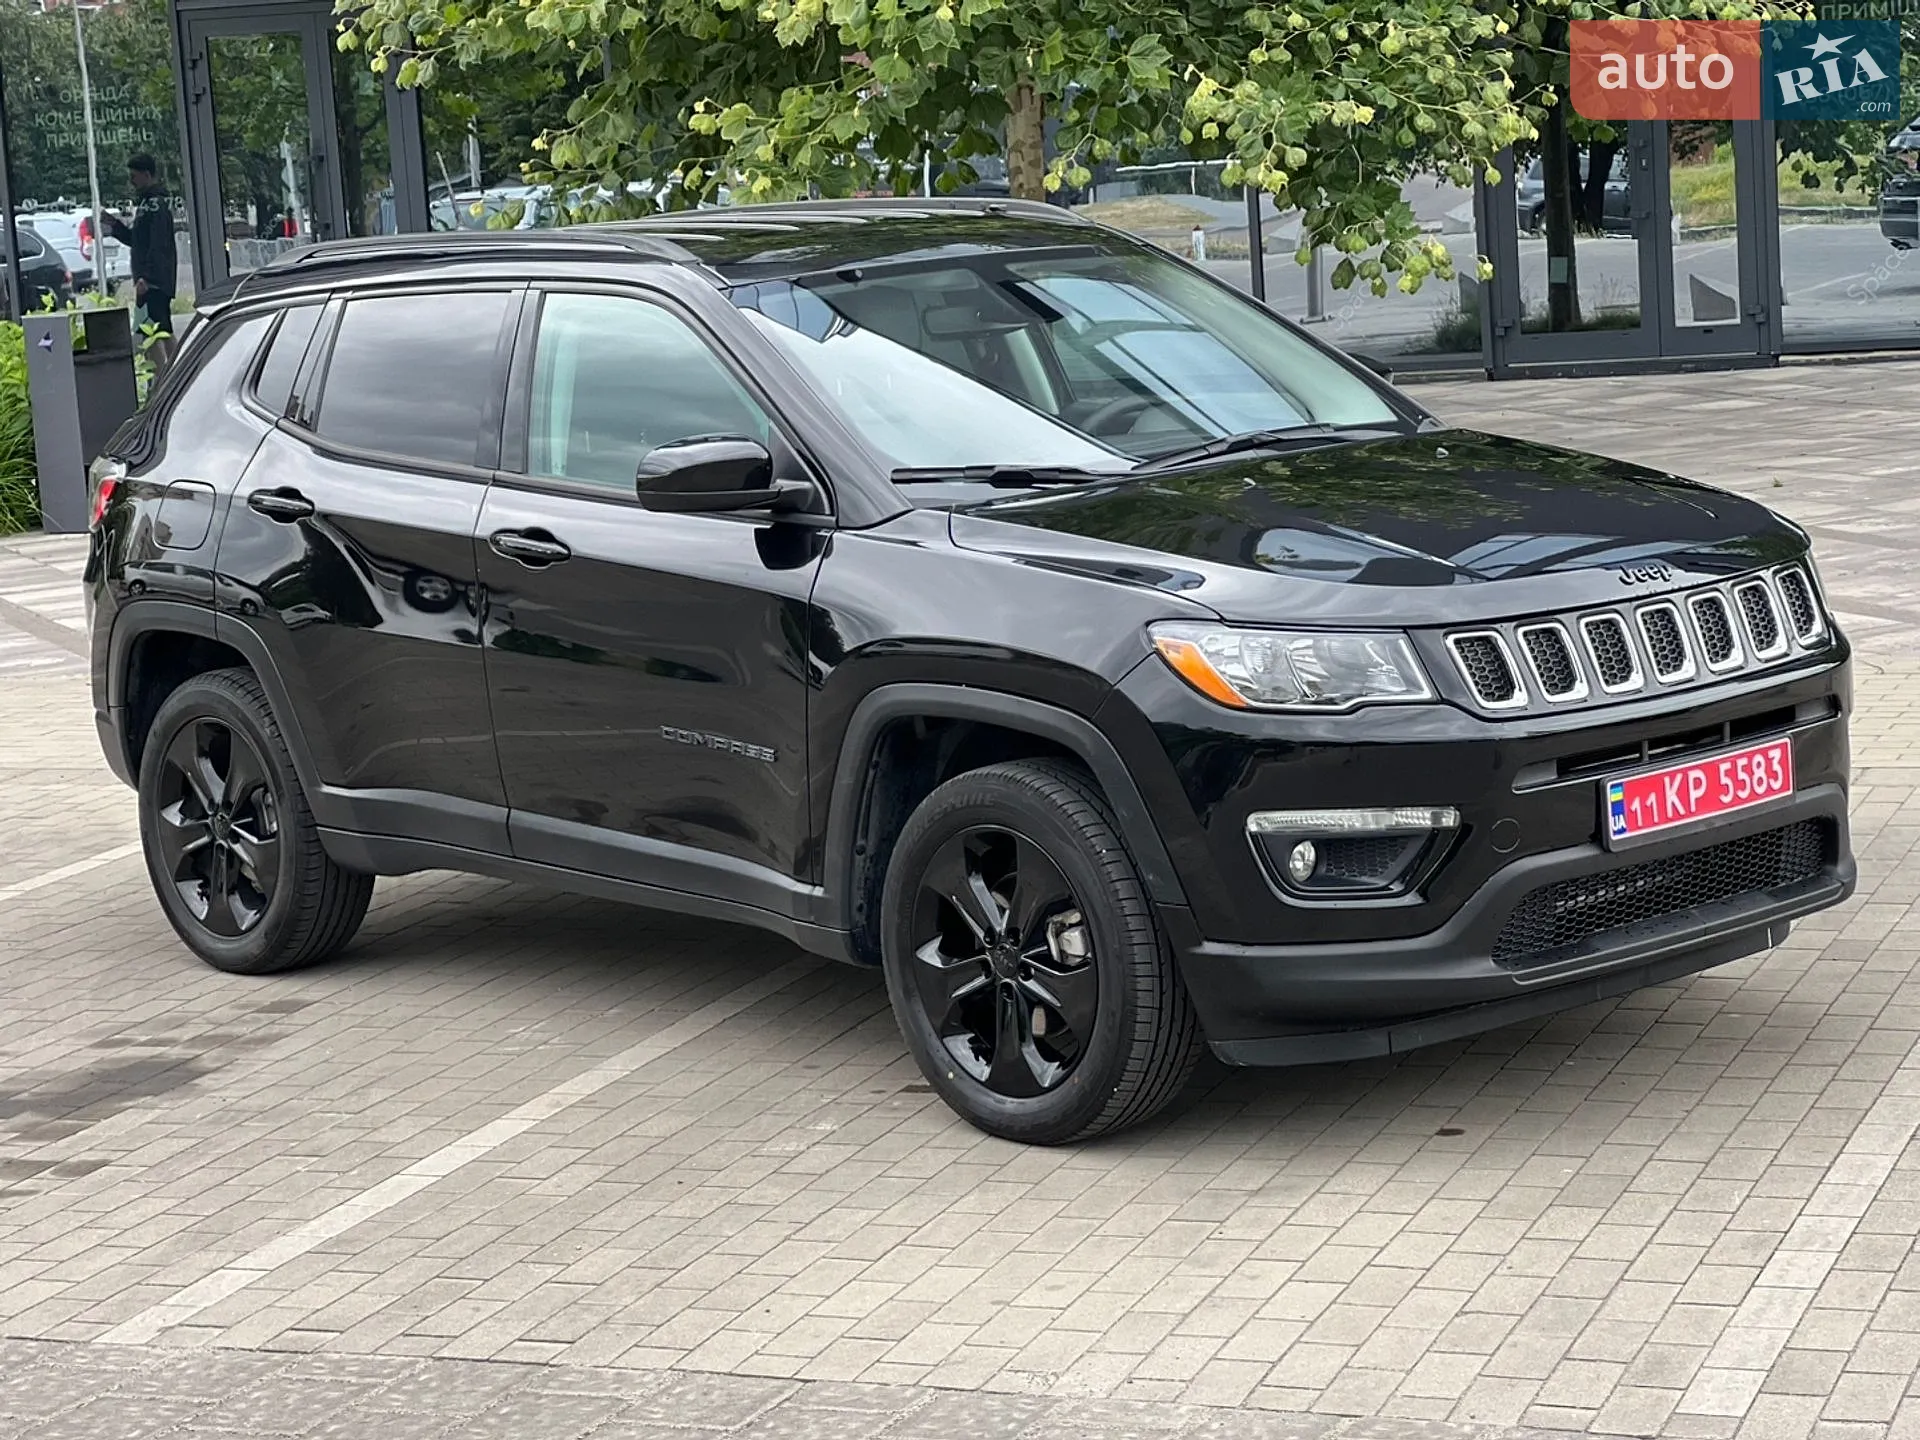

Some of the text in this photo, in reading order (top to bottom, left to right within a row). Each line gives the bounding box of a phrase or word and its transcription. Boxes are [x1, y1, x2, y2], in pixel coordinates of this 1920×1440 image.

[34, 104, 162, 127] КОМЕЦІЙНИХ
[1619, 563, 1672, 585] Jeep
[660, 725, 776, 762] COMPASS
[1719, 748, 1784, 804] 5583
[1612, 815, 1627, 831] UA
